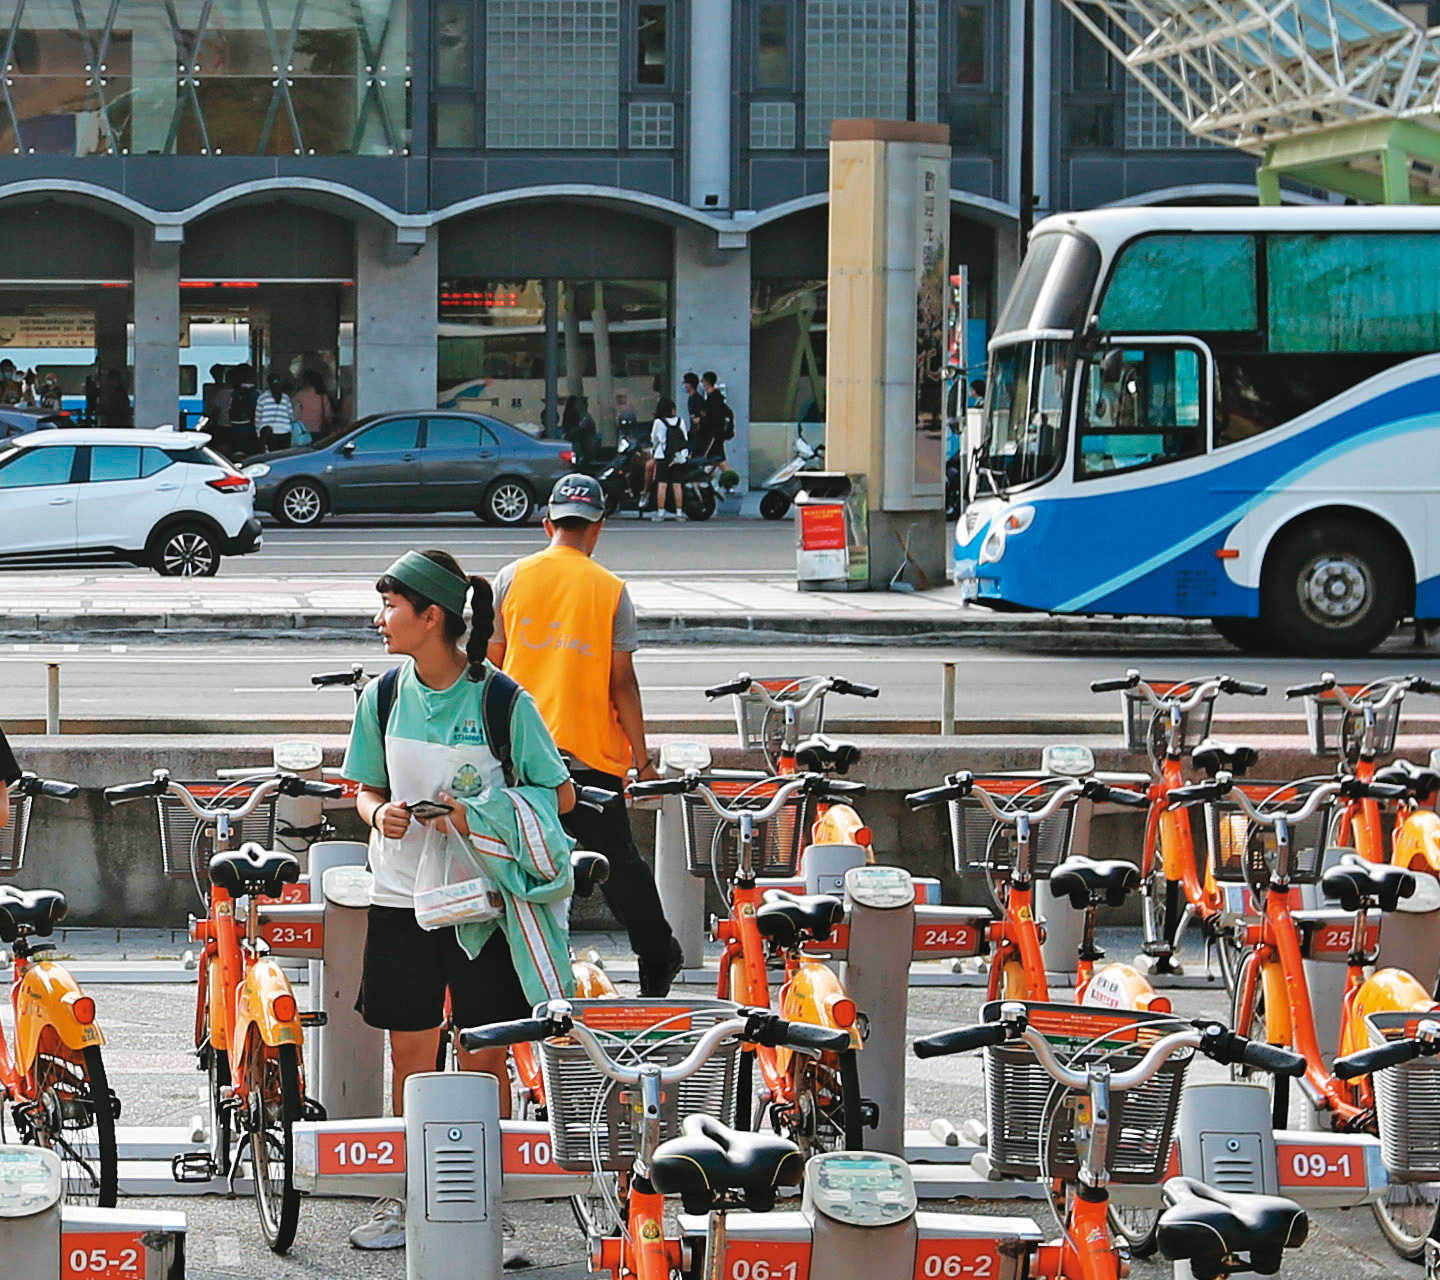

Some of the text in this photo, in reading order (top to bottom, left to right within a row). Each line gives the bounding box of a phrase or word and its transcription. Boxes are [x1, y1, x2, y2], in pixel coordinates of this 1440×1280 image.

[272, 928, 311, 942] 23-1
[925, 931, 966, 944] 24-2
[334, 1142, 393, 1164] 10-2
[518, 1142, 550, 1165] 10
[1294, 1154, 1349, 1177] 09-1
[71, 1249, 136, 1272] 05-2
[925, 1256, 991, 1276] 06-2
